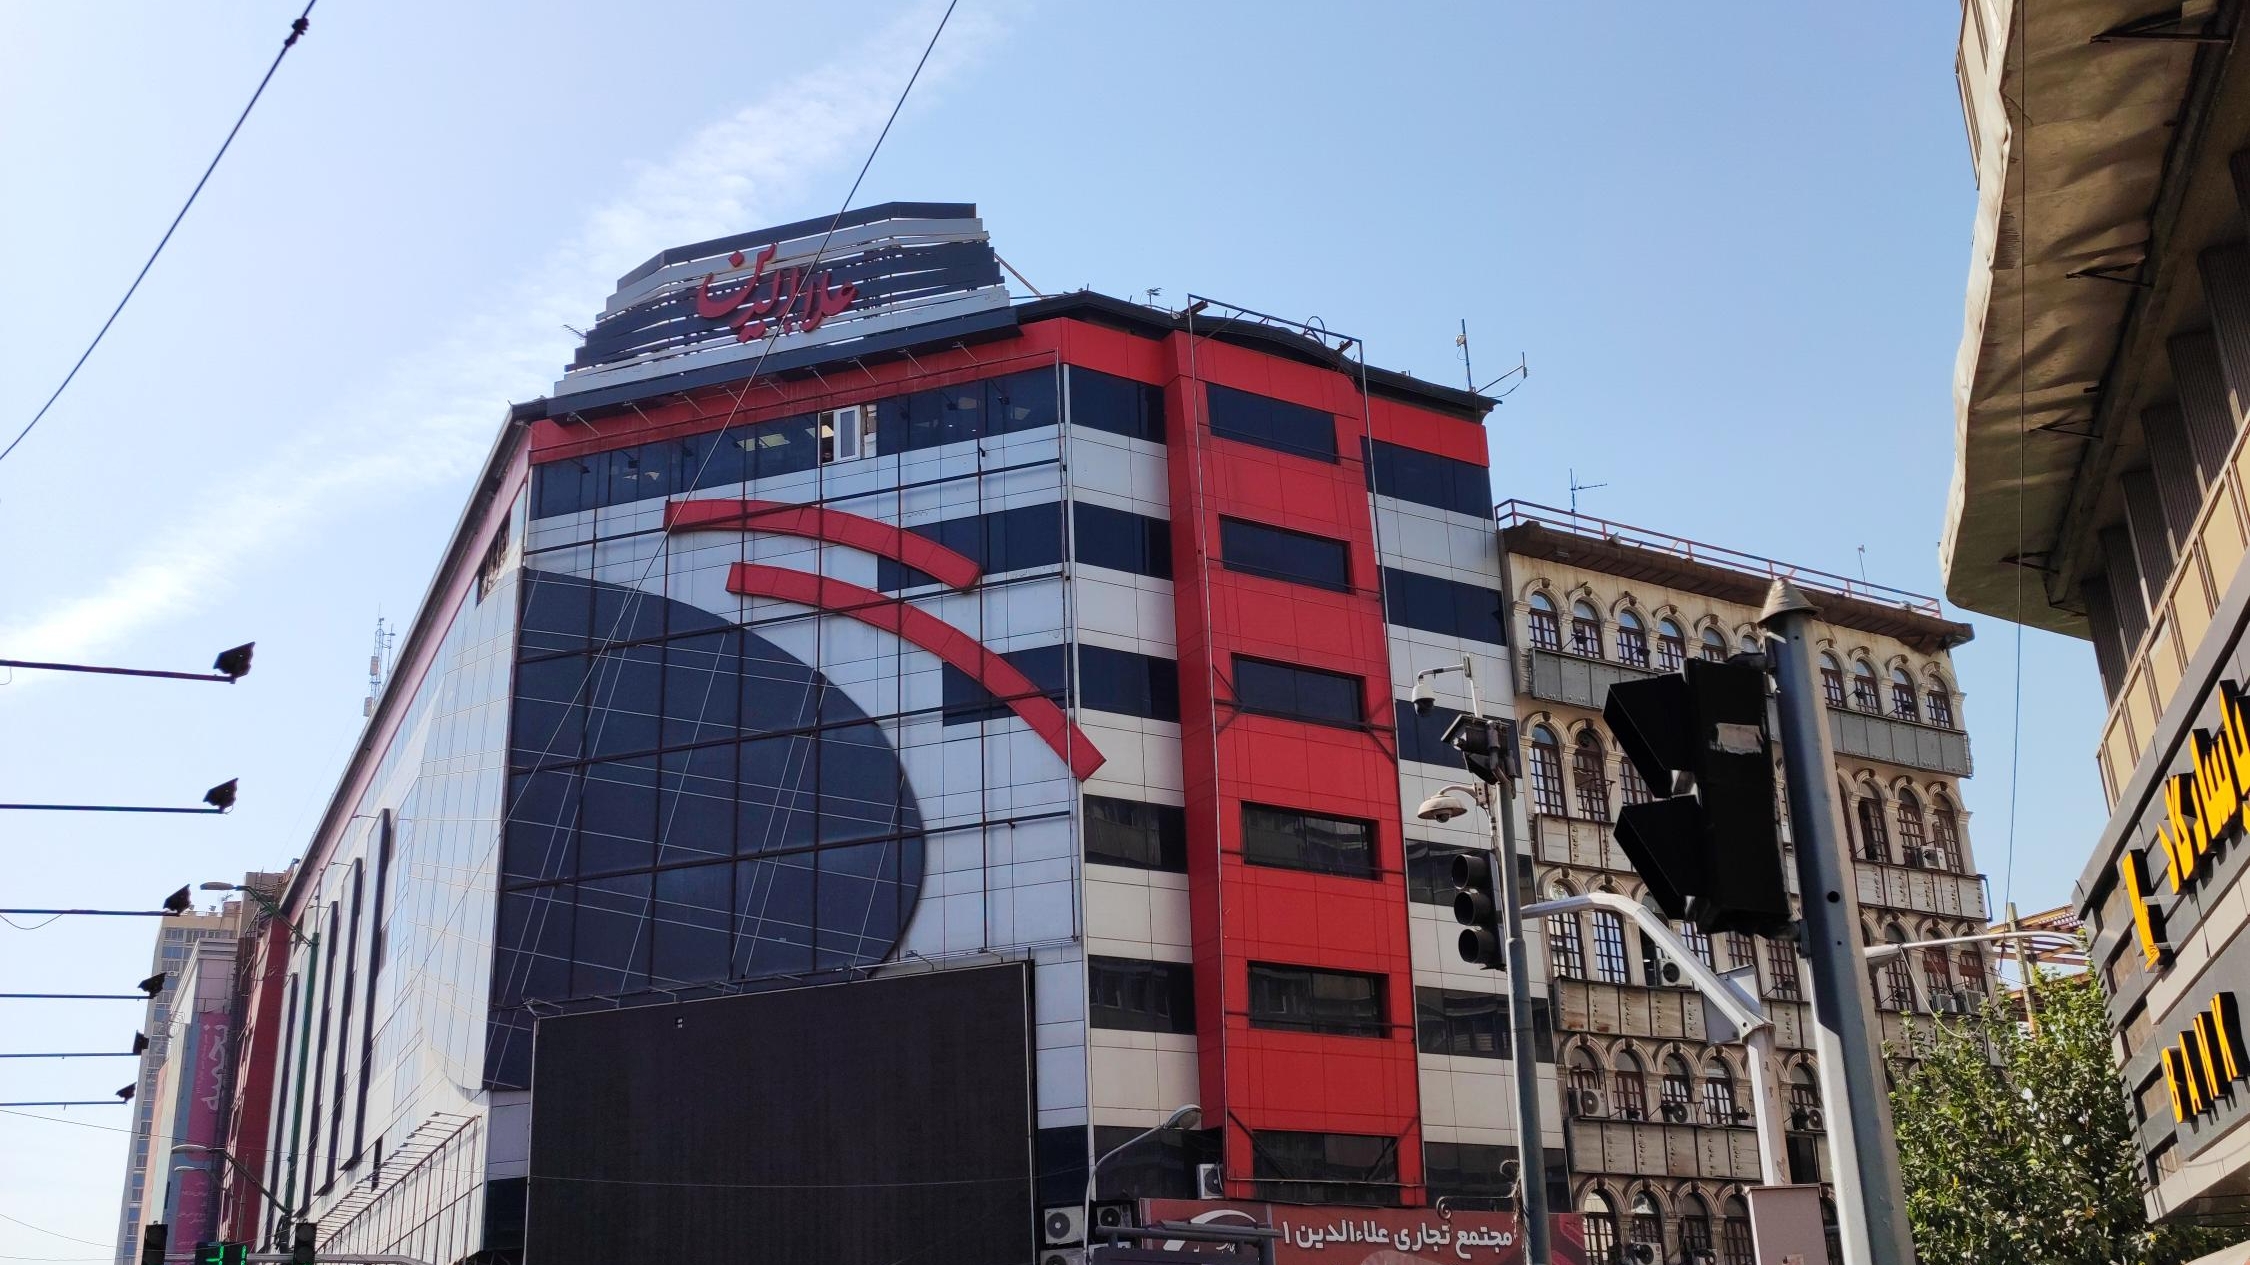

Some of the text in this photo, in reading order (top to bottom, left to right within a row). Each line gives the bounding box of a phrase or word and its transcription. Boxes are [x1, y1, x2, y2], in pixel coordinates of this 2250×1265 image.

[2161, 992, 2238, 1123] BANK
[1295, 1219, 1390, 1249] علاءالدین
[1393, 1221, 1451, 1252] تجاری
[1455, 1225, 1513, 1260] مجتمع
